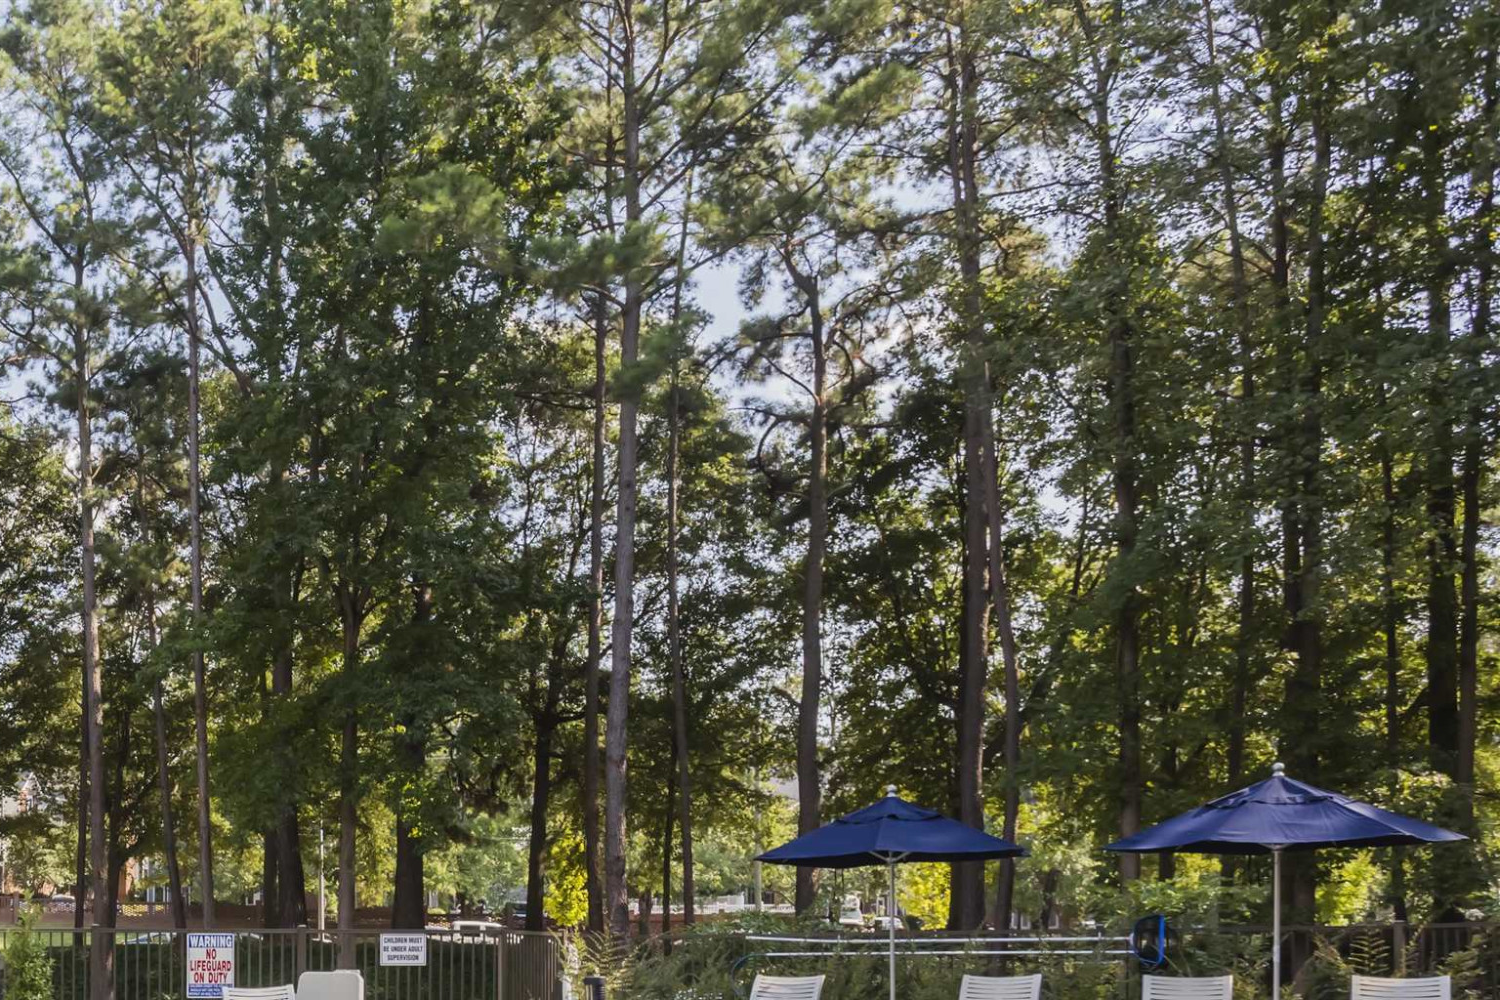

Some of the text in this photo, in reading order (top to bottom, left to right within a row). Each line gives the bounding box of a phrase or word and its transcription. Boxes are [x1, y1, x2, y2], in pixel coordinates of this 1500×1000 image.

[190, 935, 232, 948] WARNING
[206, 948, 217, 960] NO
[190, 960, 232, 971] LIFEGUARD
[194, 972, 227, 983] ON DUTY
